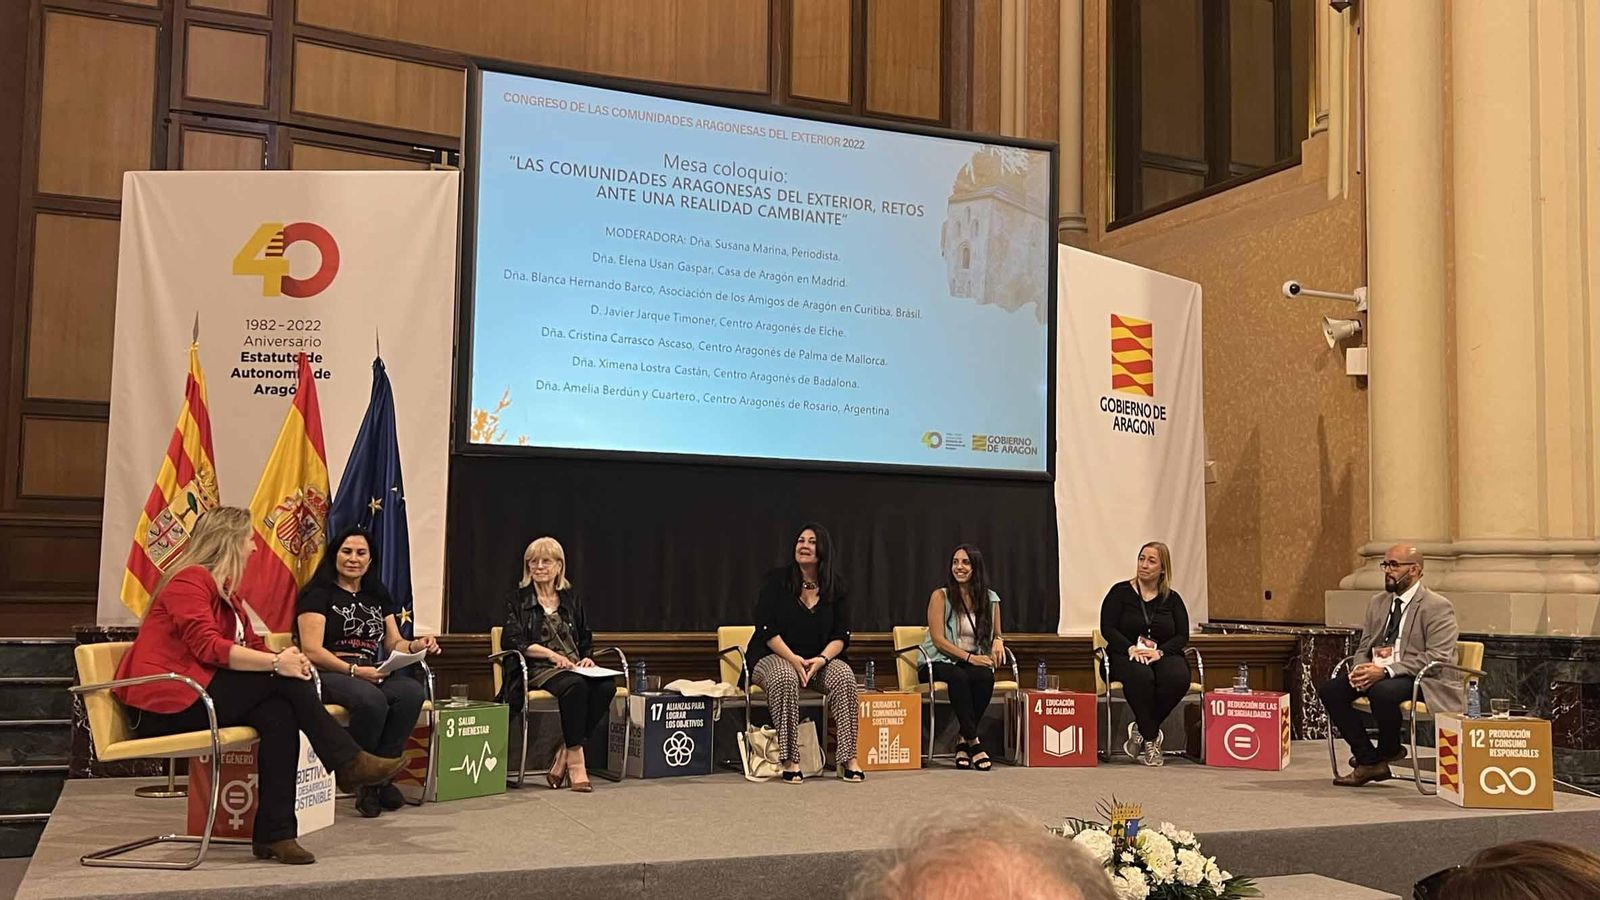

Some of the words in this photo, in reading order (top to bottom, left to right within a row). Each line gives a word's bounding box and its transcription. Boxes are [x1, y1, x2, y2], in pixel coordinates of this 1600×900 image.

[504, 92, 567, 110] CONGRESO
[570, 101, 586, 112] DE
[588, 104, 609, 116] LAS
[612, 108, 693, 128] COMUNIDADES
[696, 119, 766, 137] ARAGONESAS
[769, 128, 788, 140] DEL
[792, 132, 841, 147] EXTERIOR
[842, 138, 865, 150] 2022
[664, 153, 707, 172] Mesa
[713, 161, 788, 184] coloquio:
[550, 160, 667, 187] COMUNIDADES
[672, 176, 771, 200] ARAGONESAS
[778, 189, 803, 204] DEL
[808, 192, 876, 213] EXTERIOR,
[882, 200, 925, 217] RETOS
[597, 186, 636, 202] ANTE
[642, 191, 675, 207] UNA
[681, 196, 753, 215] REALIDAD
[606, 227, 687, 245] MODERADORA:
[716, 239, 750, 252] Susana
[792, 247, 841, 262] Periodista.
[232, 222, 340, 298] 40
[592, 252, 617, 265] Dña.
[620, 254, 647, 268] Elena
[650, 258, 674, 271] Usan
[678, 261, 714, 277] Gaspar,
[718, 266, 741, 279] Casa
[743, 267, 757, 280] de
[759, 269, 794, 286] Aragón
[798, 274, 810, 285] en
[812, 273, 848, 288] Madrid.
[504, 269, 528, 282] Dña.
[532, 272, 567, 286] Blanca
[570, 276, 622, 292] Hernando
[624, 281, 656, 295] Barco,
[659, 284, 712, 300] Asociación
[715, 290, 729, 302] de
[731, 291, 745, 303] los
[749, 294, 785, 309] Amigos
[787, 297, 800, 308] de
[802, 298, 837, 315] Aragón
[840, 303, 852, 313] en
[854, 304, 893, 318] Curitiba,
[591, 304, 602, 316] D.
[604, 306, 635, 320] Javier
[637, 308, 671, 323] Jarque
[673, 312, 717, 328] Timoner,
[719, 317, 753, 330] Centro
[756, 320, 801, 338] Aragonés
[803, 323, 817, 336] de
[819, 325, 847, 338] Elche.
[244, 336, 322, 347] Aniversario
[541, 326, 566, 340] Dña.
[568, 329, 608, 343] Cristina
[610, 332, 655, 347] Carrasco
[658, 337, 695, 352] Ascaso,
[699, 341, 732, 354] Centro
[735, 343, 781, 360] Aragonés
[784, 347, 797, 359] de
[799, 349, 828, 363] Palma
[830, 351, 843, 363] de
[846, 352, 888, 367] Mallorca.
[306, 352, 323, 363] de
[231, 368, 299, 379] Autonom
[314, 368, 331, 379] de
[572, 356, 597, 369] Dña.
[599, 358, 638, 372] Ximena
[640, 362, 671, 375] Lostra
[674, 364, 711, 379] Castán,
[714, 368, 747, 381] Centro
[750, 371, 796, 388] Aragonés
[798, 374, 811, 386] de
[813, 376, 860, 390] Badalona.
[254, 384, 297, 397] Aragó
[536, 380, 561, 392] Dña.
[563, 382, 600, 395] Amelia
[602, 385, 640, 398] Berdún
[642, 390, 649, 401] y
[703, 393, 737, 405] Centro
[739, 396, 785, 412] Aragonés
[788, 399, 800, 410] de
[803, 401, 841, 415] Rosario,
[844, 404, 890, 418] Argentina
[1100, 397, 1151, 418] GOBIERNO
[1154, 406, 1166, 420] DE
[1113, 416, 1155, 436] ARAGON
[988, 436, 1031, 446] GOBIERNO
[988, 445, 998, 453] DE
[1002, 446, 1038, 455] ARAGON
[666, 702, 691, 711] ALIANZAS
[692, 702, 705, 710] PARA
[860, 701, 870, 718] 11
[1035, 699, 1042, 715] 4
[1046, 698, 1075, 707] EDUCACIÓN
[1211, 700, 1225, 716] 10
[1227, 701, 1258, 710] REDUCCIÓN
[651, 704, 663, 721] 17
[666, 711, 686, 720] LOGRAR
[872, 709, 907, 717] COMUNIDADES
[1227, 709, 1272, 719] DESIGUALDADES
[447, 718, 455, 738] 3
[459, 717, 475, 726] SALUD
[666, 721, 676, 729] LOS
[677, 719, 704, 728] OBJETIVOS
[462, 726, 490, 736] BIENESTAR
[1469, 729, 1485, 748] 12
[1489, 729, 1531, 739] PRODUCCIÓN
[1495, 740, 1527, 748] CONSUMO
[1489, 749, 1539, 758] RESPONSABLES
[295, 789, 332, 811] OSTENIBLE
